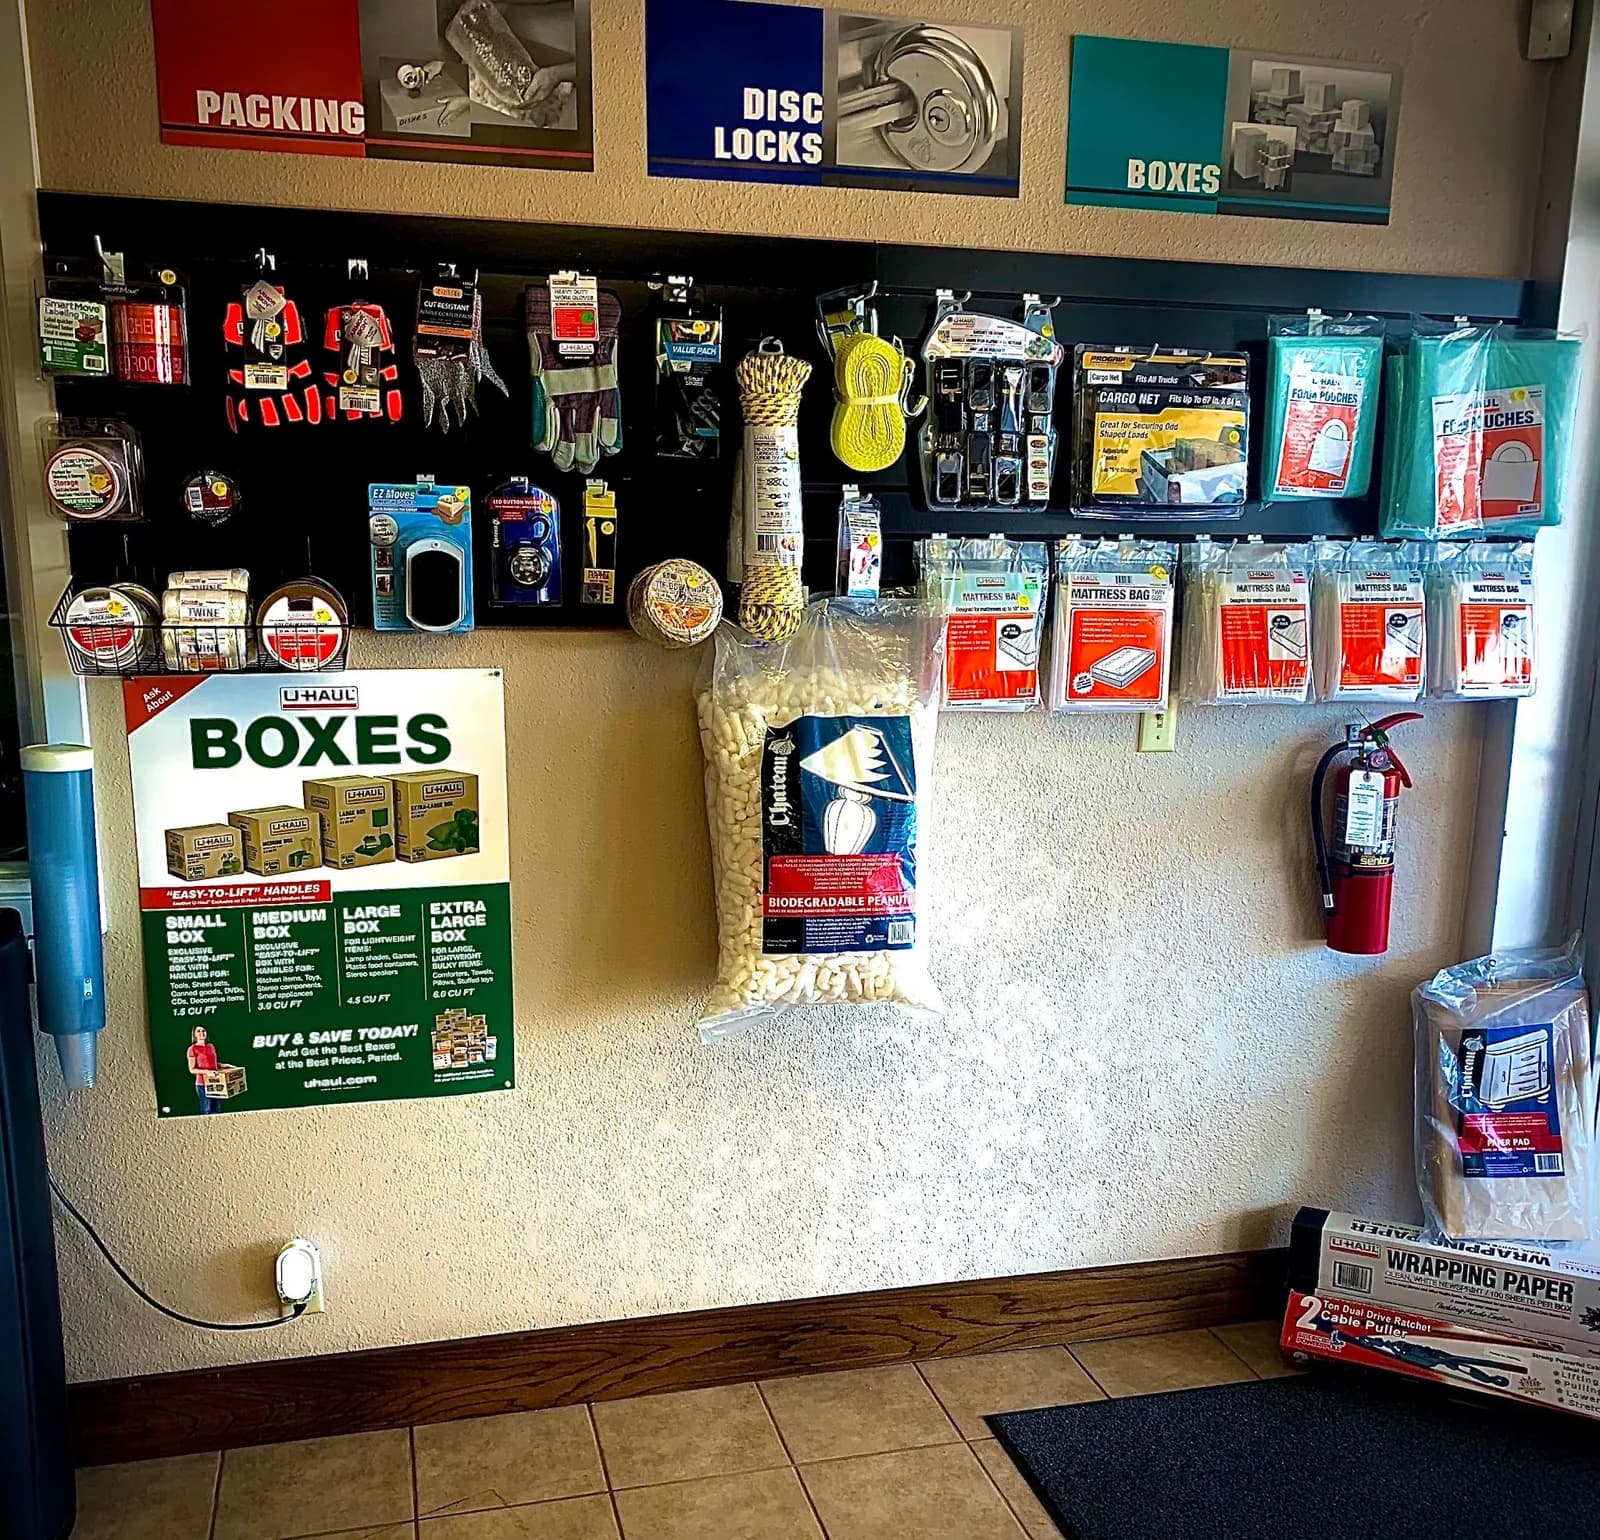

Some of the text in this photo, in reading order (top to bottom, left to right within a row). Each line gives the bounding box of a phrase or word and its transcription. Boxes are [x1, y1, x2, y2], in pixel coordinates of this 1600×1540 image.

[743, 87, 823, 124] DISC
[197, 89, 365, 135] PACKING
[714, 126, 822, 165] LOCKS
[1127, 158, 1221, 194] BOXES
[424, 300, 470, 311] CUT RESISTANT
[697, 347, 717, 355] PACK
[1091, 372, 1108, 382] Cargo
[1135, 374, 1178, 384] Fits All Trucks
[1099, 391, 1161, 405] CARGO NET
[1169, 394, 1182, 403] Fits
[1182, 395, 1193, 404] Up
[1202, 396, 1212, 404] 67
[1320, 391, 1358, 403] POUCHES
[1100, 421, 1119, 429] Great
[1121, 421, 1131, 429] for
[1132, 421, 1163, 431] Securing
[1100, 430, 1149, 439] Shaped Loads
[373, 489, 416, 500] EZ Moves
[1071, 588, 1126, 600] MATTRESS
[1129, 589, 1150, 600] BAG
[1236, 584, 1291, 592] MATTRESS BAG
[1355, 584, 1407, 592] MATTRESS BAG
[1473, 585, 1519, 593] MATTRESS BAG
[963, 592, 1004, 601] MATTRESS
[189, 607, 220, 617] TWINE
[142, 686, 161, 703] Ask
[283, 688, 355, 702] U-HAUL
[145, 690, 174, 713] About
[189, 713, 452, 769] BOXES
[348, 789, 384, 800] U-HAUL
[425, 783, 462, 794] U-HAUL
[767, 755, 789, 826] Chateau
[272, 819, 307, 831] U-HAUL
[197, 837, 232, 848] U-HAUL
[264, 884, 320, 896] HANDLES
[430, 900, 486, 915] EXTRA
[769, 896, 865, 908] BIODEGRADABLE
[252, 908, 326, 925] MEDIUM
[343, 904, 401, 920] LARGE
[166, 914, 227, 929] SMALL
[344, 920, 380, 934] BOX
[431, 914, 486, 929] LARGE
[166, 930, 205, 944] BOX
[253, 925, 291, 939] BOX
[431, 929, 466, 943] BOX
[254, 942, 299, 951] EXCLUSIVE
[344, 935, 416, 946] FOR LIGHTWEIGHT
[168, 947, 213, 956] EXCLUSIVE
[344, 945, 371, 954] ITEMS:
[255, 959, 272, 967] BOX
[432, 952, 482, 962] LIGHTWEIGHT
[169, 963, 209, 972] BOX WITH
[256, 966, 294, 975] HANDLES
[432, 960, 484, 970] BULKY ITEMS:
[170, 970, 230, 980] HANDLES FOR:
[369, 969, 398, 978] speakers
[347, 993, 391, 1004] 4.5 CU FT
[432, 988, 475, 998] 6.0 CU FT
[173, 1005, 217, 1017] 1.5 CU FT
[257, 1000, 303, 1011] 3.0 CU FT
[253, 1023, 419, 1049] BUY & SAVE TODAY!
[278, 1042, 396, 1058] And Get the Best Boxes
[275, 1053, 403, 1070] at the Best Prices, Period.
[304, 1075, 377, 1089] uhaul.com
[1512, 1138, 1530, 1146] PAD
[1332, 1237, 1380, 1254] U-HAUL
[1387, 1249, 1497, 1288] WRAPPING
[1503, 1271, 1574, 1303] PAPER
[1385, 1270, 1572, 1312] CLEAN, WHITE NEWSPRINT 100 SHEETS PER BOX
[1296, 1295, 1431, 1333] 2 Ton Dual Drive Ratchet
[1321, 1310, 1408, 1338] Cable Puller
[1532, 1352, 1585, 1368] Strong Powerful
[1563, 1365, 1579, 1373] Ideal
[1561, 1371, 1598, 1386] Lifting
